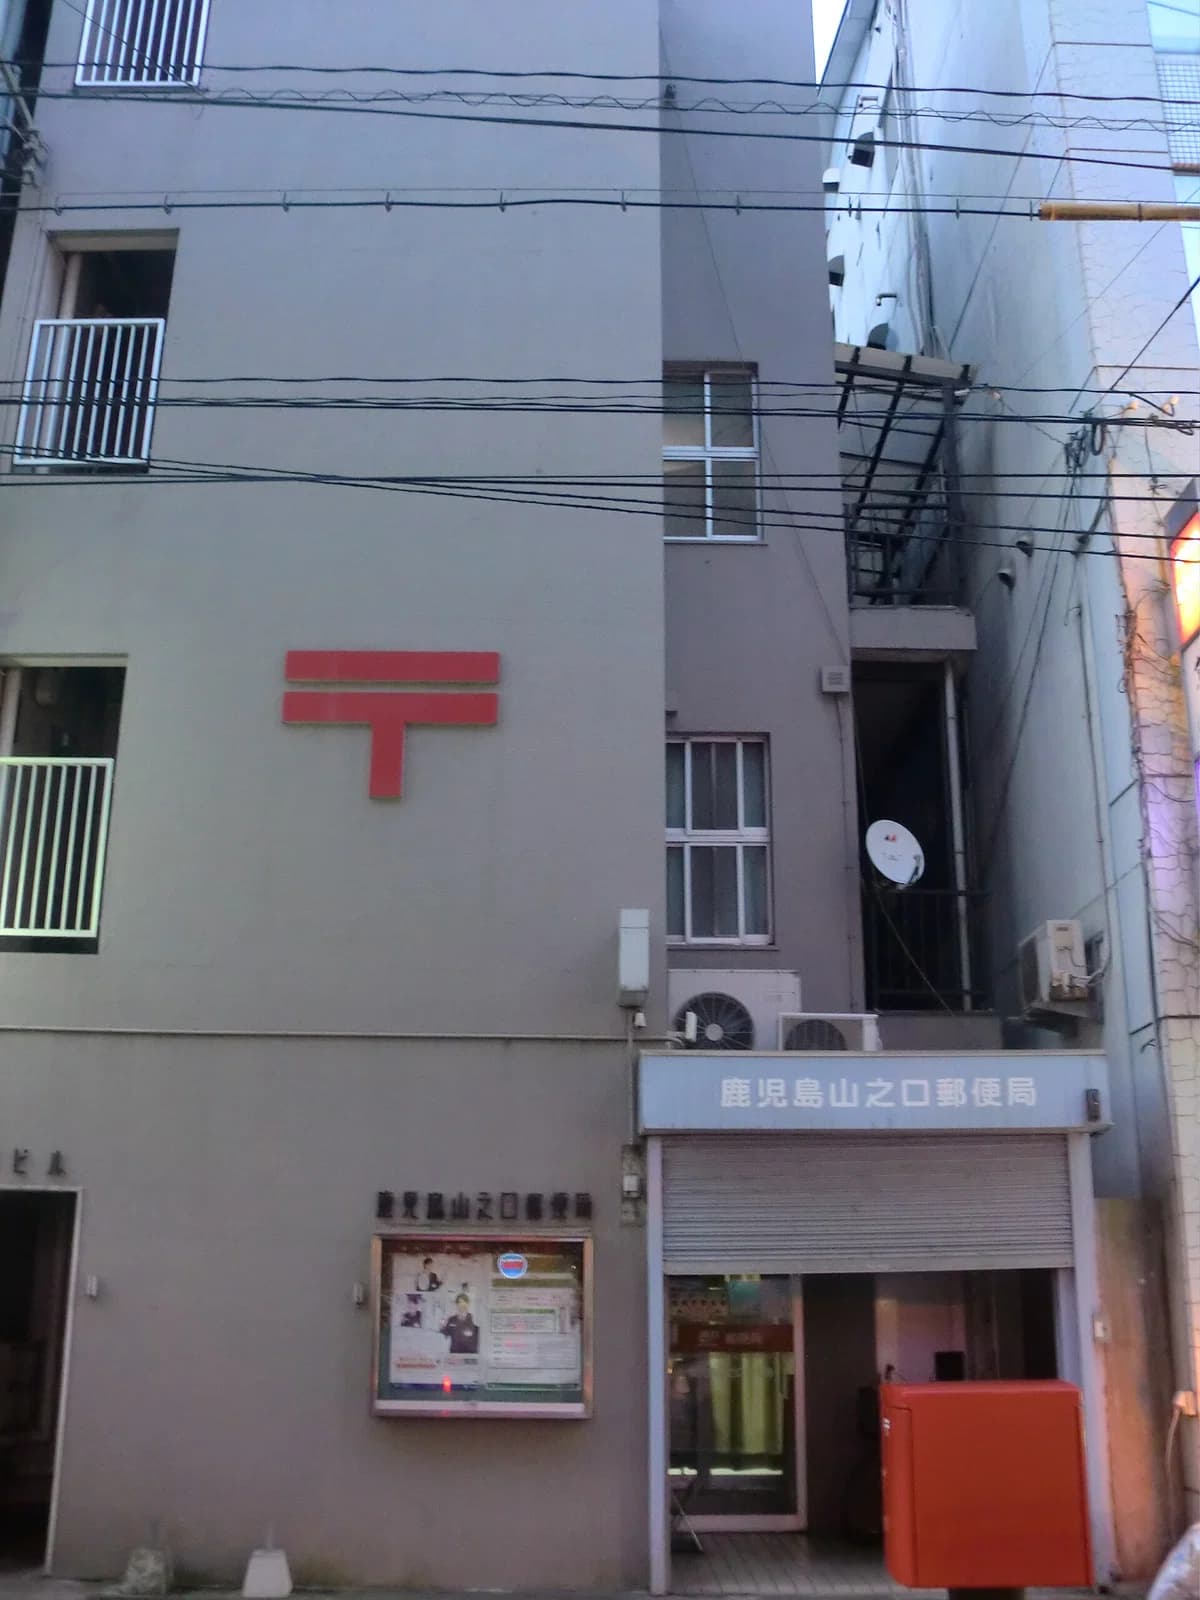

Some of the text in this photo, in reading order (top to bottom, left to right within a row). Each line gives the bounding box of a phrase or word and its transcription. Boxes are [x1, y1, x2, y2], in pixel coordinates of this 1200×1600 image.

[719, 1077, 1037, 1108] 鹿児島山之口郵便局
